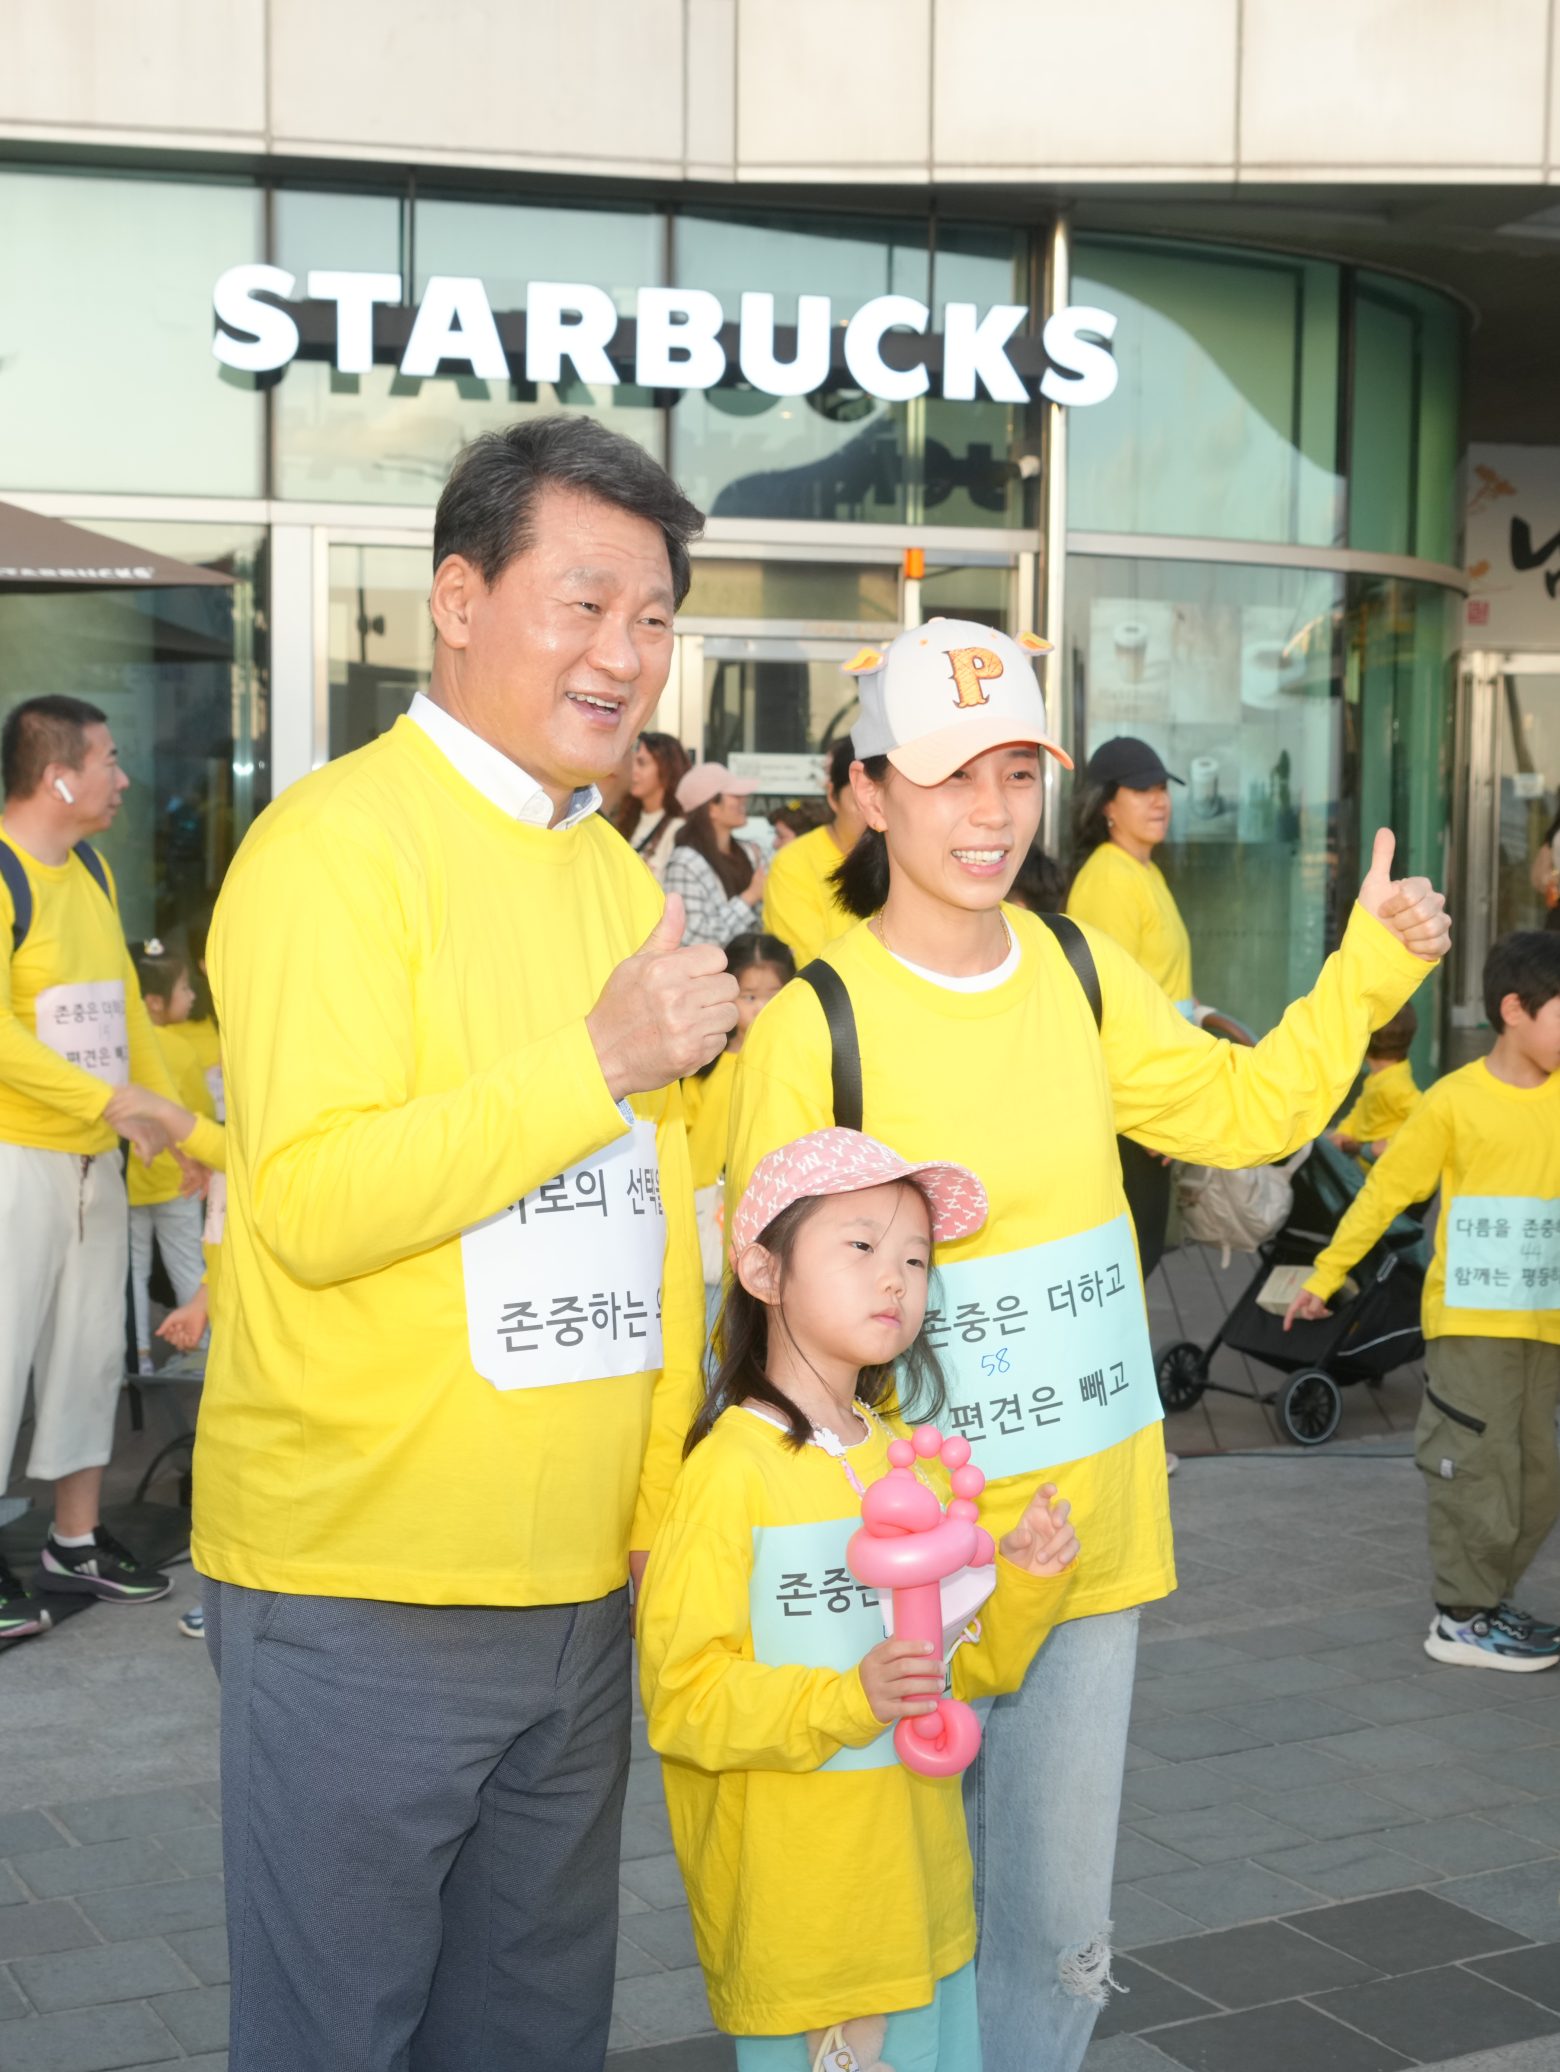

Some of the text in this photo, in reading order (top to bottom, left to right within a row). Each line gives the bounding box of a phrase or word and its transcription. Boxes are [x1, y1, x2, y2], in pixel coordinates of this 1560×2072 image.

[211, 264, 1118, 406] STARBUCKS
[941, 647, 1004, 708] P
[507, 1169, 608, 1225] 로의
[1456, 1218, 1560, 1238] 다름을 존중
[921, 1263, 1125, 1349] 존중은 더하고
[1455, 1266, 1511, 1287] 함께는
[497, 1290, 648, 1352] 존중하는
[981, 1347, 1010, 1376] 58
[949, 1361, 1129, 1443] 편견은 빼고
